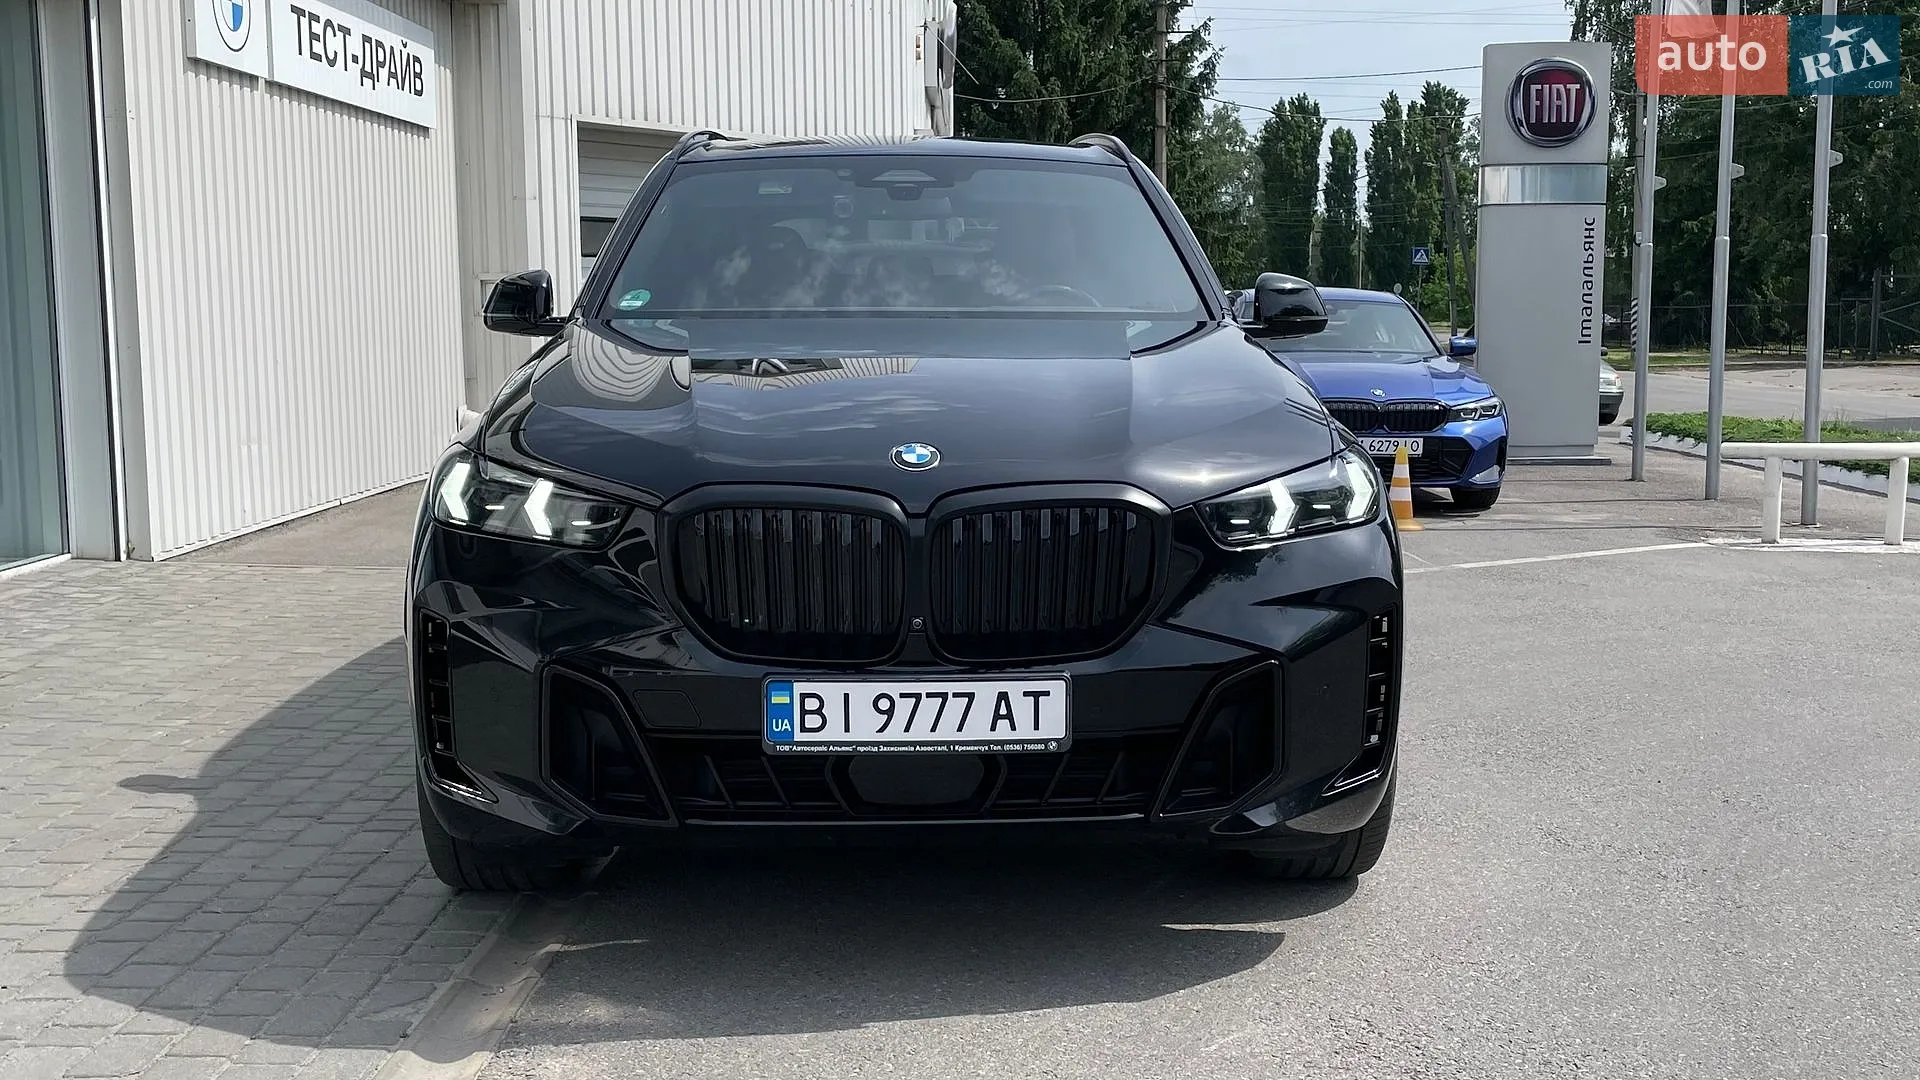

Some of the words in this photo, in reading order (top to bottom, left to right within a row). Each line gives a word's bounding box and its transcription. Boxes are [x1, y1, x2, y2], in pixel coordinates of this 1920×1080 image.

[290, 4, 424, 97] ТЕСТ-ДРАЙВ
[1529, 84, 1580, 123] FIAT
[1368, 440, 1399, 452] 6279
[772, 719, 791, 732] UA
[799, 692, 851, 733] BI
[872, 691, 976, 733] 9777
[989, 690, 1051, 732] AT
